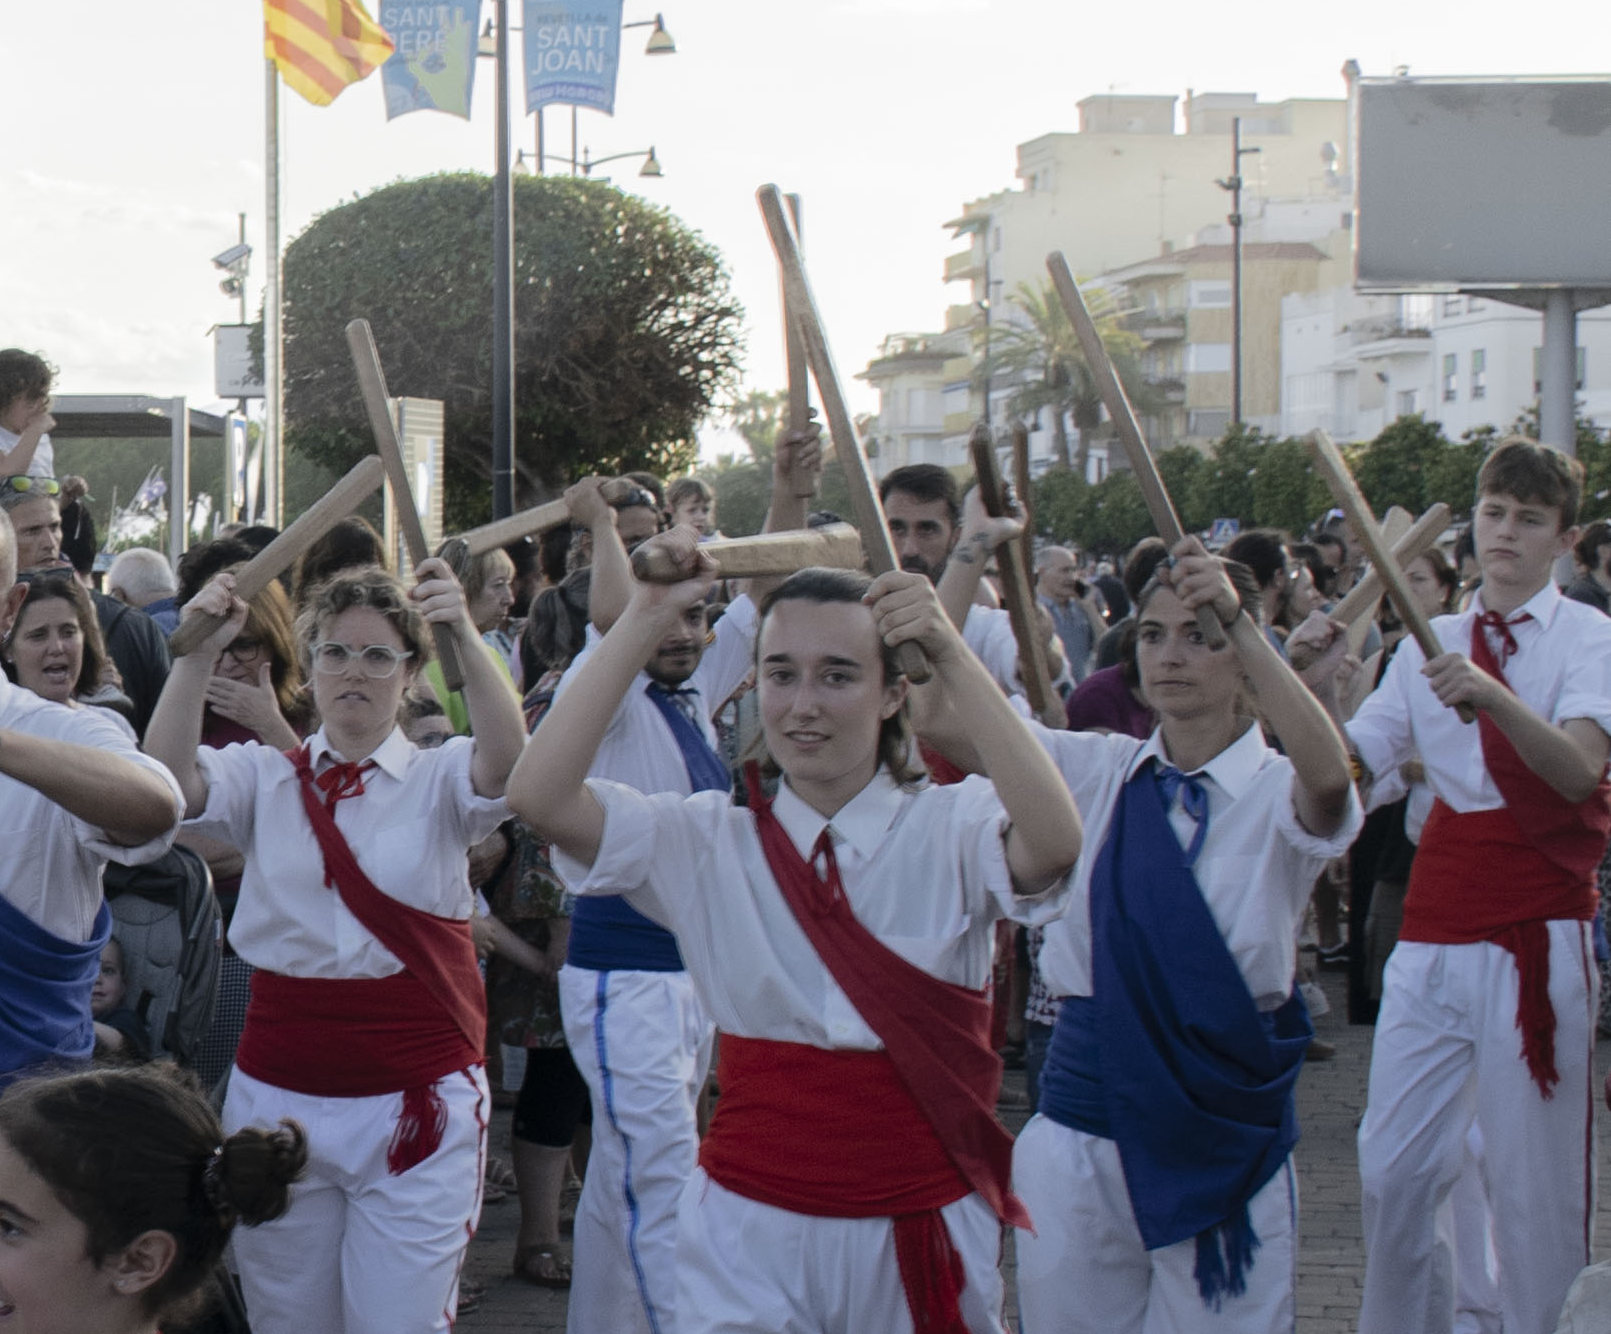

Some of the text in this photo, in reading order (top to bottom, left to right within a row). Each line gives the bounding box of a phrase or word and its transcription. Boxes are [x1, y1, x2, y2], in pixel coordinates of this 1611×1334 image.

[384, 4, 450, 28] SANT
[538, 24, 609, 49] SANT
[531, 48, 605, 75] JOAN
